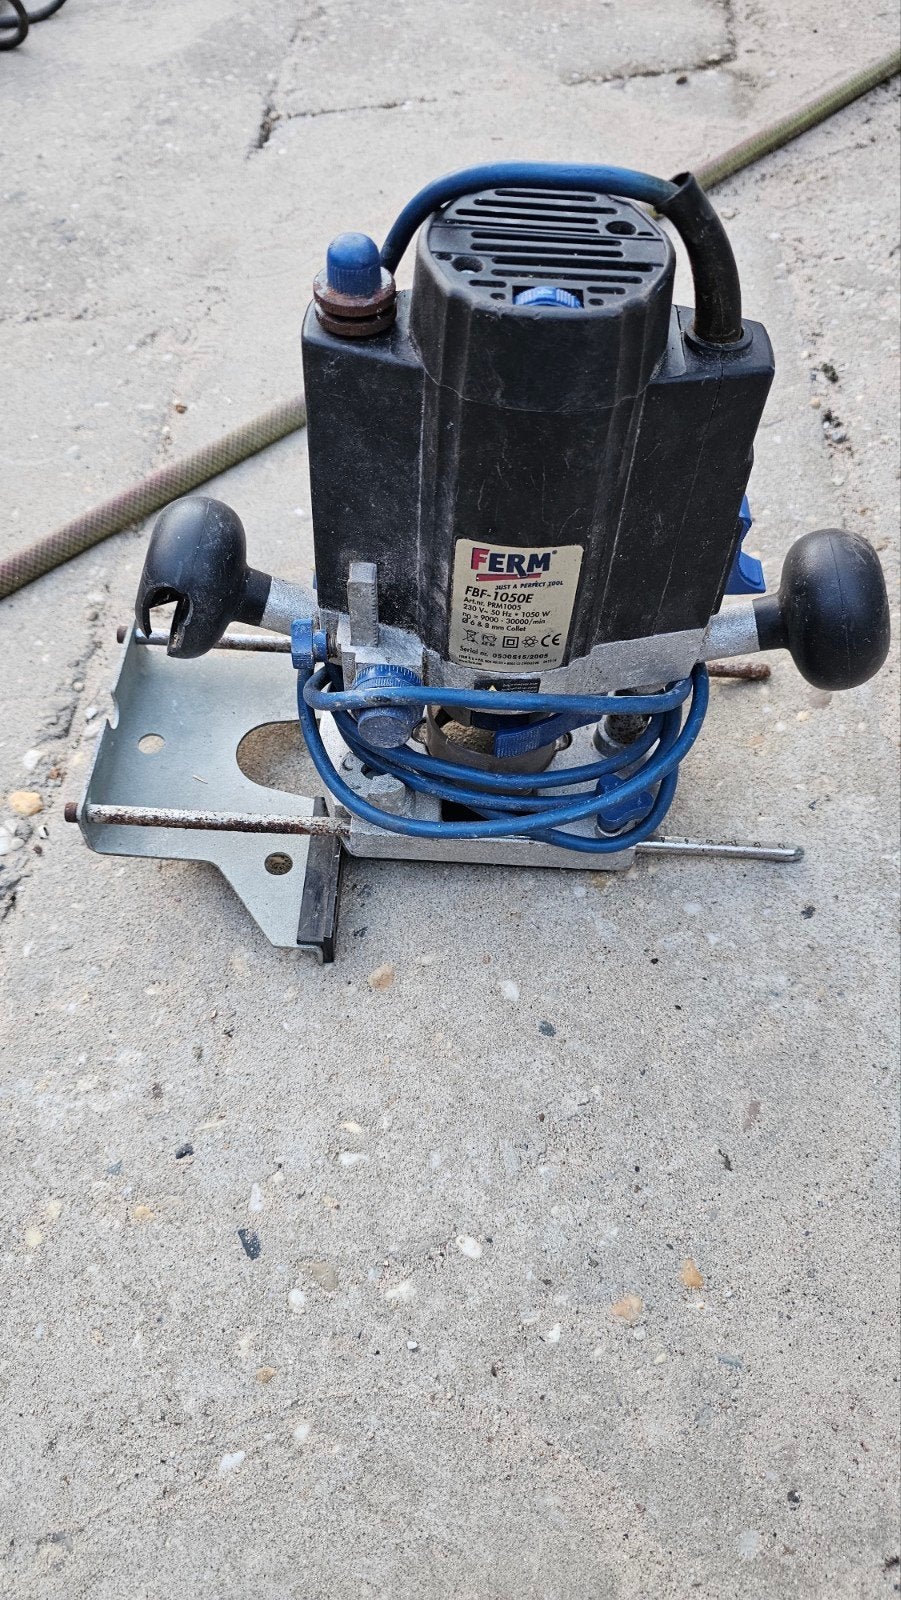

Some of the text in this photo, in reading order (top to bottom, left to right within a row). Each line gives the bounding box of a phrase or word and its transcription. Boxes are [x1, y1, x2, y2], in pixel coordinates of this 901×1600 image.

[471, 547, 551, 577] FERM
[465, 586, 534, 603] FBF-1050E
[463, 603, 477, 611] 230
[487, 601, 521, 610] PRM1005
[480, 614, 499, 622] 9000
[460, 645, 478, 654] Serial
